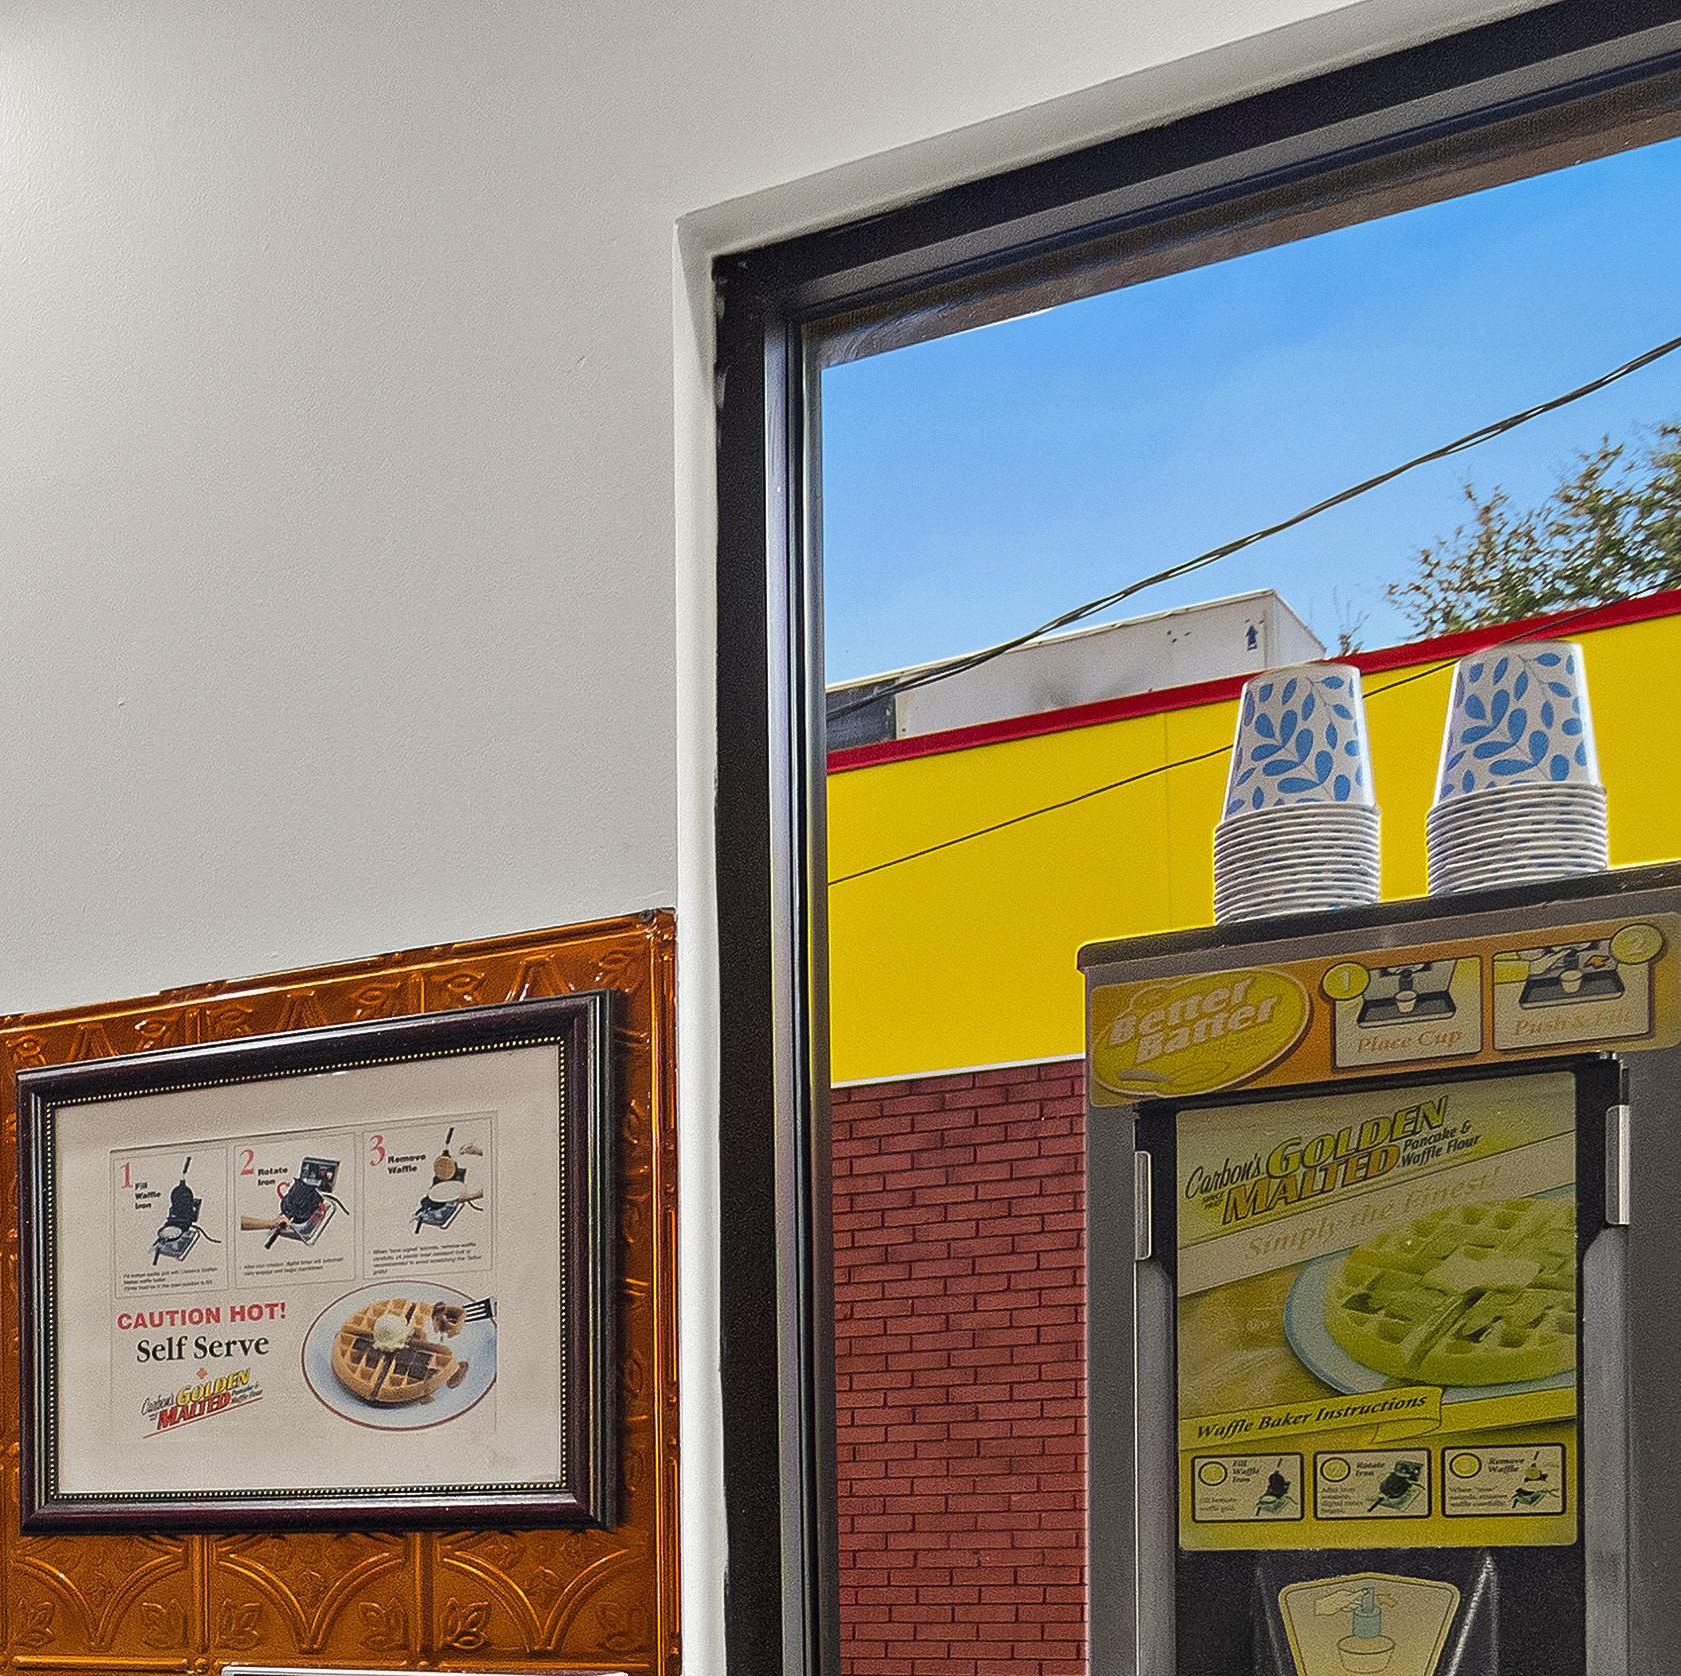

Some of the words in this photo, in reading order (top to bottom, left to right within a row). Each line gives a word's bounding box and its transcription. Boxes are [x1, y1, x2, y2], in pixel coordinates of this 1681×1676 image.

[1340, 970, 1352, 991] 1
[1109, 976, 1257, 1045] Better
[1136, 996, 1278, 1063] Batter
[1514, 1014, 1566, 1036] Push
[1356, 1036, 1411, 1053] Place
[1417, 1029, 1463, 1049] Cup
[1185, 1154, 1264, 1200] Carbon's
[1266, 1095, 1449, 1179] GOLDEN
[1403, 1126, 1457, 1152] Pancake
[1460, 1119, 1472, 1135] &
[240, 1149, 254, 1175] 2
[369, 1134, 386, 1167] 3
[388, 1154, 426, 1164] Remove
[1402, 1146, 1442, 1168] Waffle
[1445, 1134, 1482, 1157] Flour
[120, 1162, 133, 1189] 1
[258, 1167, 288, 1177] Rotate
[258, 1178, 276, 1187] Iron
[388, 1165, 417, 1174] Waffle
[135, 1191, 162, 1200] Waffle
[1222, 1145, 1401, 1226] MALTED
[1245, 1217, 1344, 1260] Simply
[1349, 1202, 1395, 1230] the
[1403, 1163, 1503, 1215] Finest!
[117, 1307, 221, 1330] CAUTION
[230, 1302, 287, 1323] HOT!
[136, 1335, 188, 1363] Self
[193, 1336, 270, 1360] Serve
[176, 1367, 251, 1406] GOLDEN
[157, 1392, 231, 1431] MALTED
[1197, 1417, 1254, 1440] Waffle
[1258, 1413, 1313, 1430] Baker
[1315, 1396, 1428, 1423] Instructions
